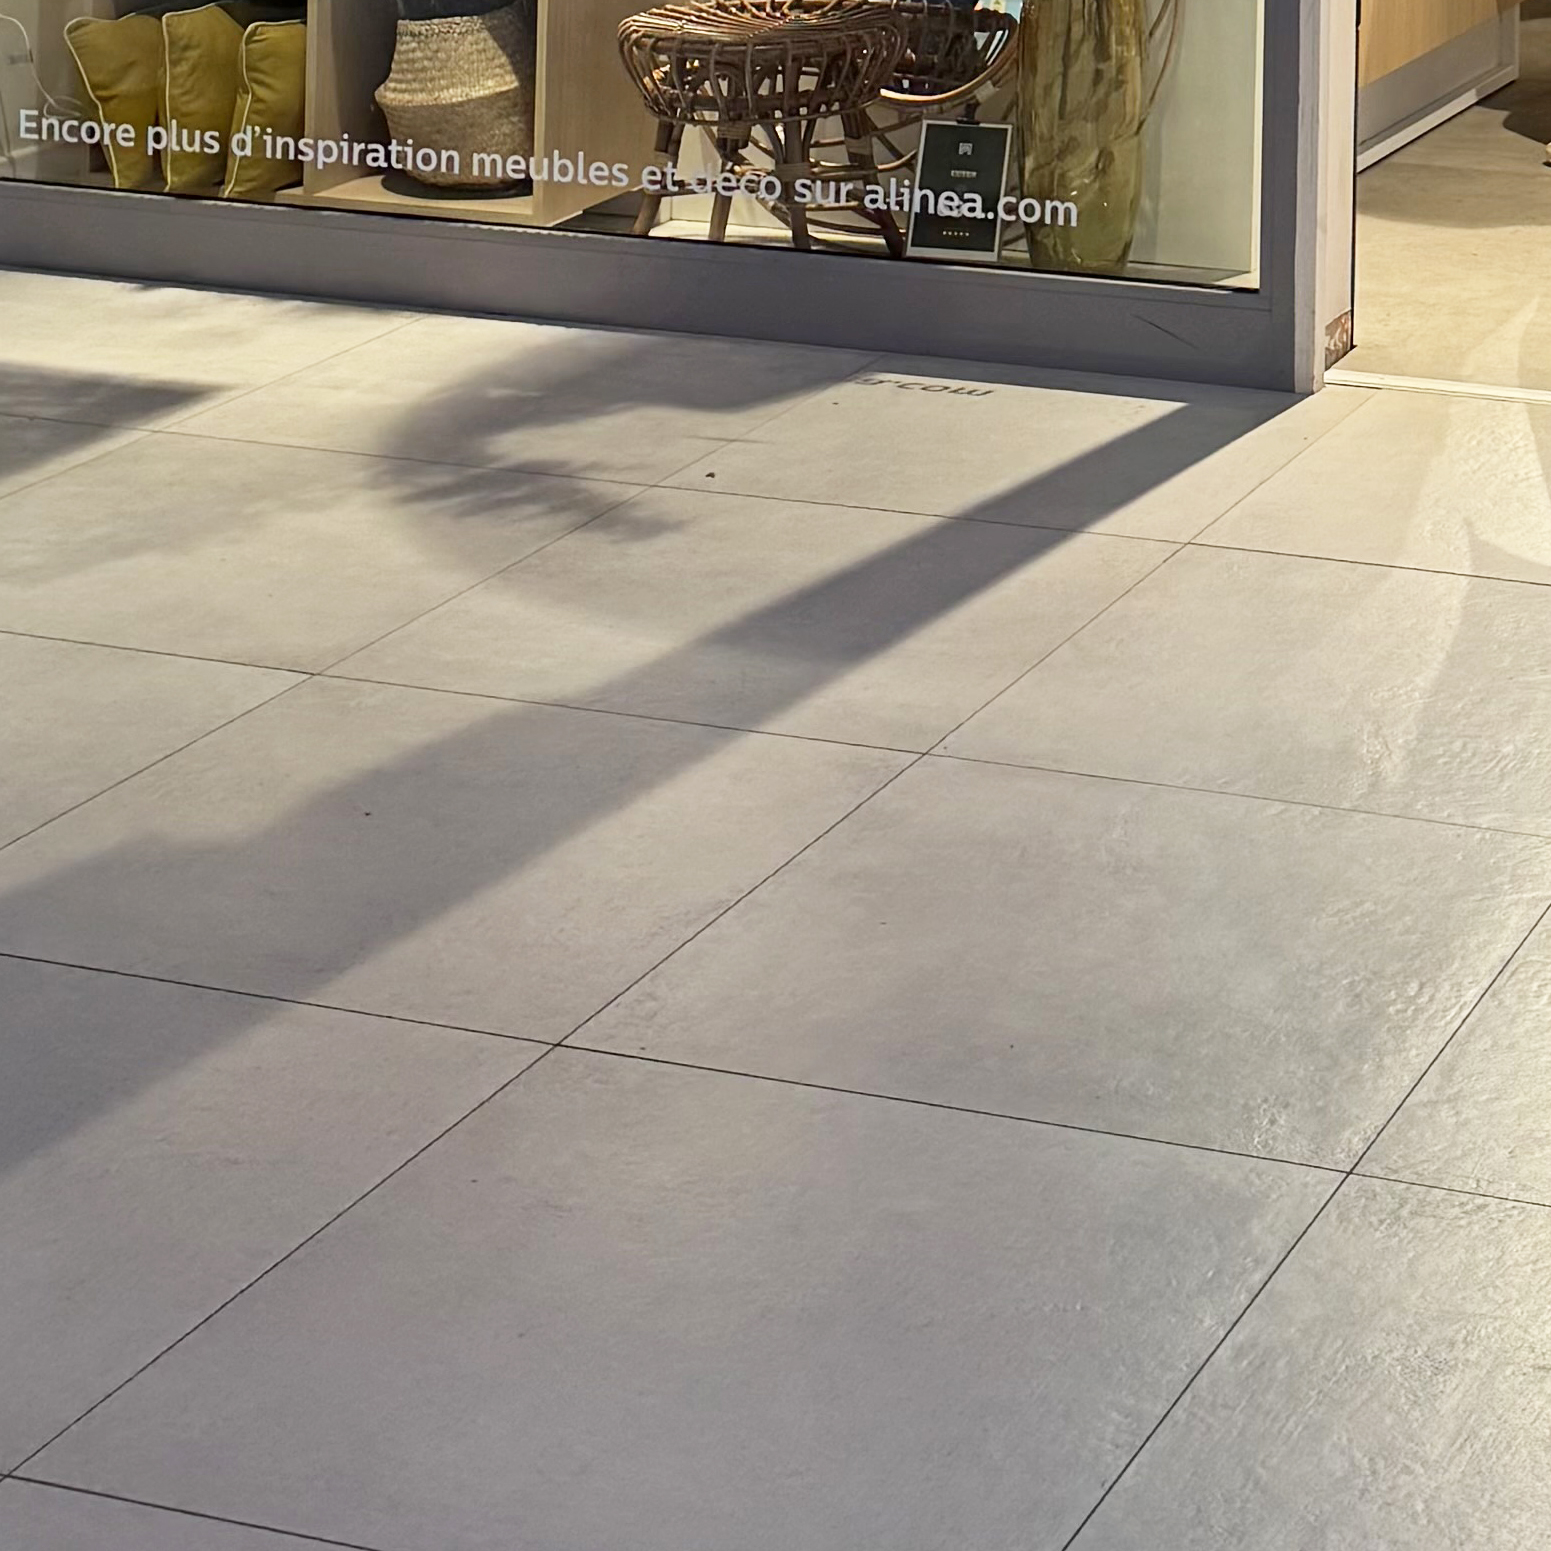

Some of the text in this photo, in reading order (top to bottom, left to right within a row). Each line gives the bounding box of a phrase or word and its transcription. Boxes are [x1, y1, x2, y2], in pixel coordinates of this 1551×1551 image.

[19, 108, 1079, 228] Encore plus d'inspiration meubles et déco sur alinea.com
